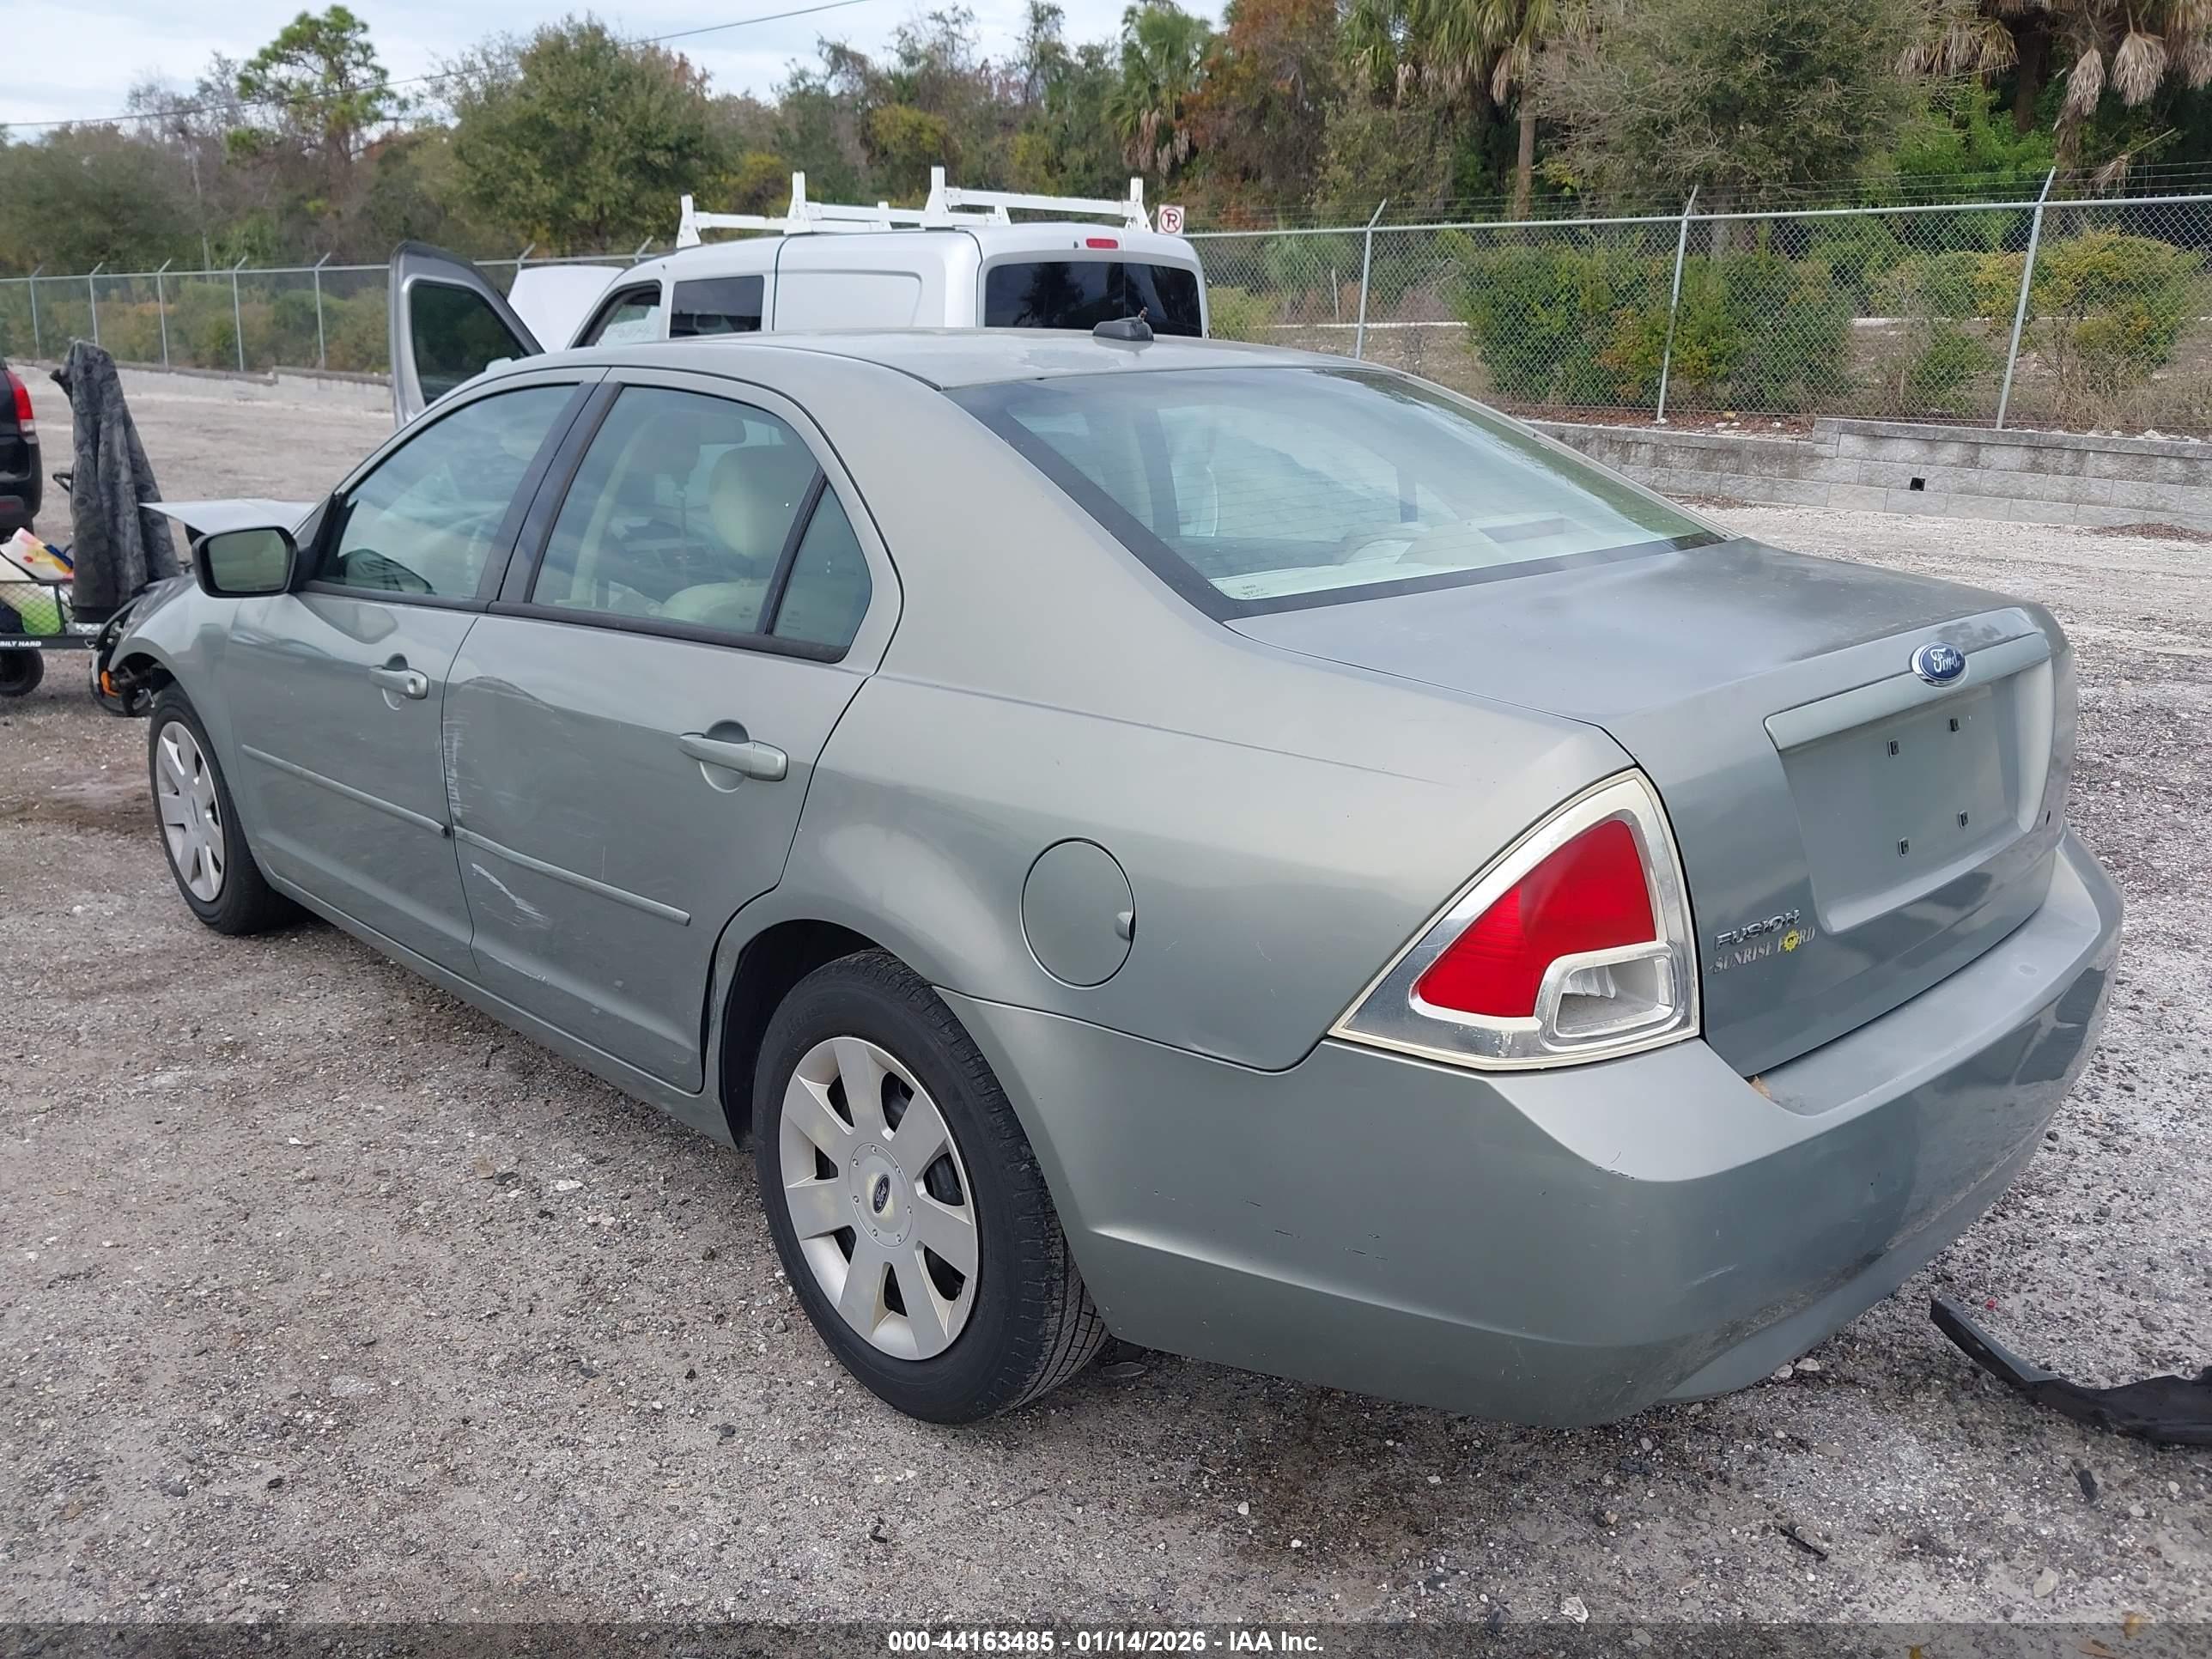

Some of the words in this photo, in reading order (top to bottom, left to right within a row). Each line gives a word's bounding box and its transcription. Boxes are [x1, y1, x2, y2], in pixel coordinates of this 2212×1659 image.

[1929, 647, 1960, 673] Ford
[1715, 908, 1800, 951] FUSION
[1711, 942, 1773, 972] SUNRISE
